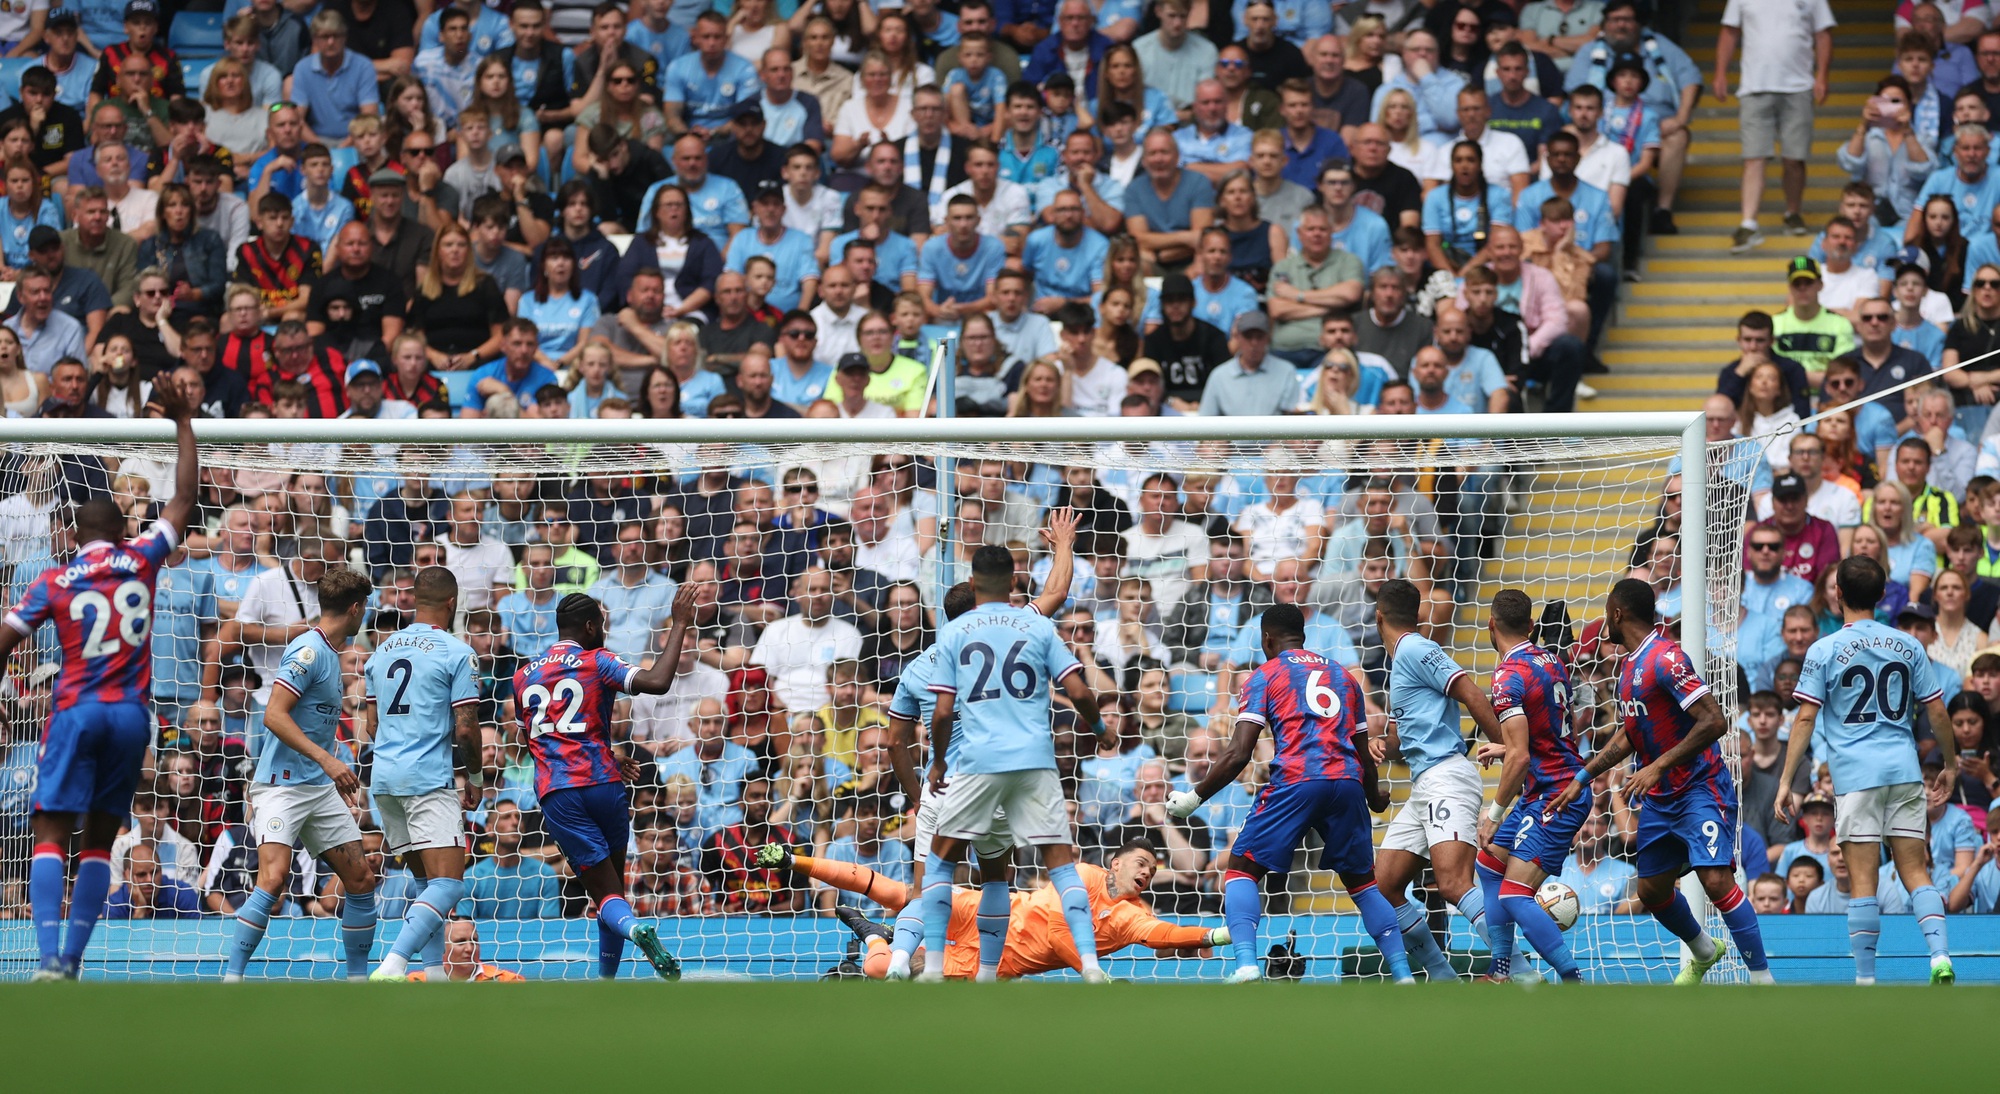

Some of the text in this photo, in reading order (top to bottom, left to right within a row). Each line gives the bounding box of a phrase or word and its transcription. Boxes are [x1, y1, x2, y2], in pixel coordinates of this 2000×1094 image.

[69, 580, 150, 659] 28
[962, 615, 1030, 634] MAHREZ
[384, 636, 435, 653] WALKER
[1836, 637, 1913, 665] BERNARDO
[523, 653, 583, 676] EDOUARD
[960, 640, 1037, 703] 26
[1429, 653, 1446, 667] TIRE
[1532, 653, 1558, 667] WARD
[386, 658, 413, 715] 2
[1305, 670, 1341, 718] 6
[1674, 673, 1698, 690] mukuru
[1841, 661, 1910, 725] 20
[522, 678, 587, 739] 22
[1553, 681, 1571, 738] 2
[1428, 799, 1451, 824] 16
[1515, 815, 1534, 839] 2
[1701, 820, 1719, 847] 9
